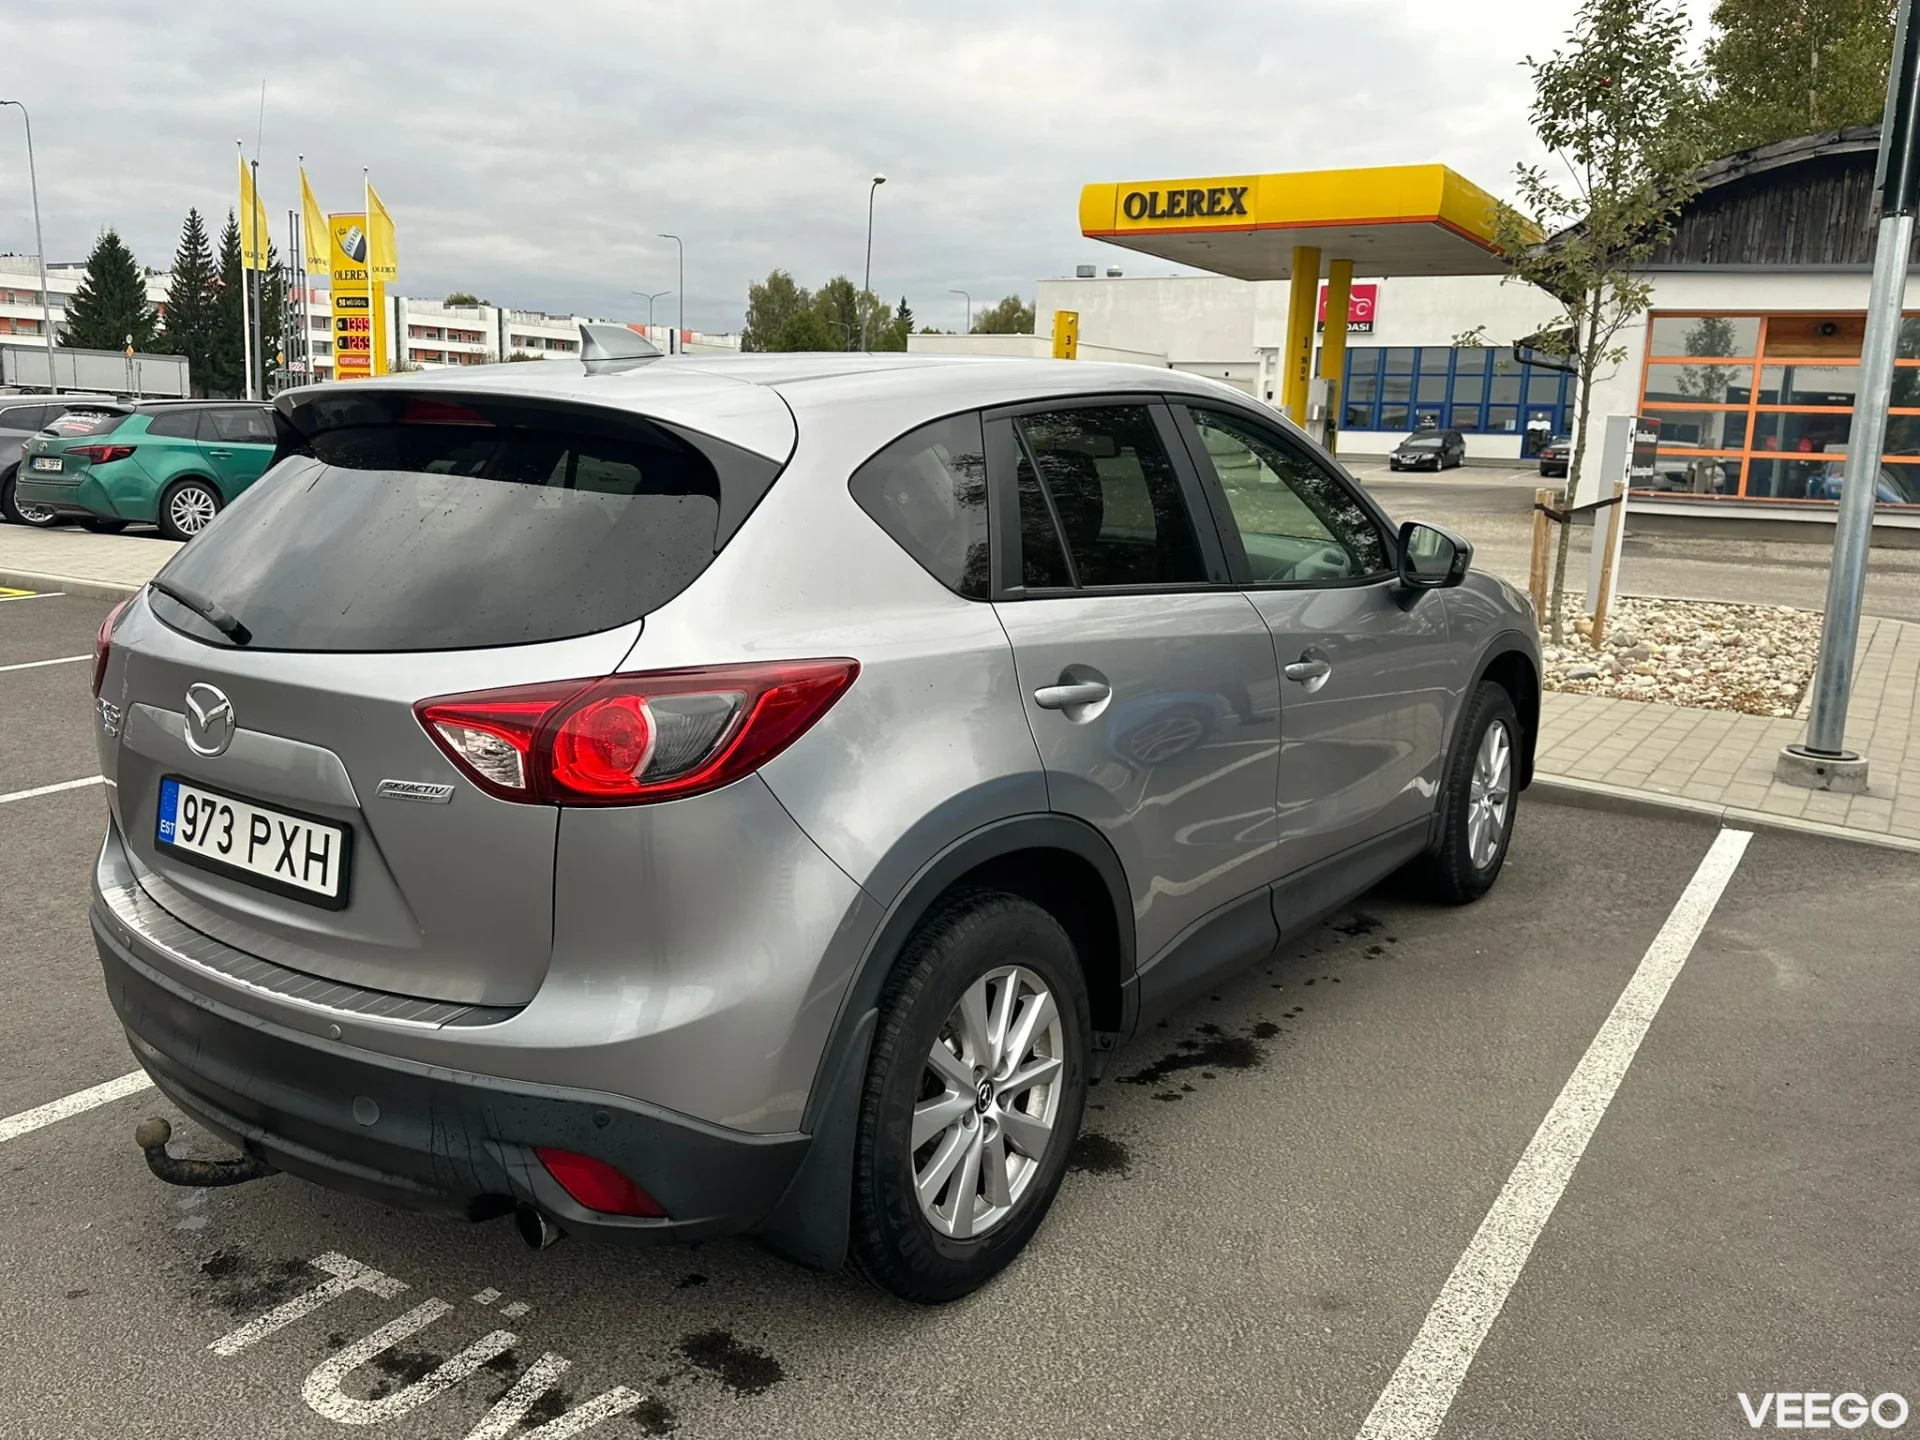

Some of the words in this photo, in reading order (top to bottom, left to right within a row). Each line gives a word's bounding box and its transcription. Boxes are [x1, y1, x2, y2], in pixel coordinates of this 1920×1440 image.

[1123, 186, 1248, 220] OLEREX
[334, 269, 369, 281] OLEREX
[1065, 335, 1072, 345] 3
[383, 781, 445, 794] SKYACTIV
[389, 792, 435, 801] TECHNOLOGY
[160, 819, 175, 835] EST
[182, 793, 234, 855] 973
[247, 818, 331, 887] PXH
